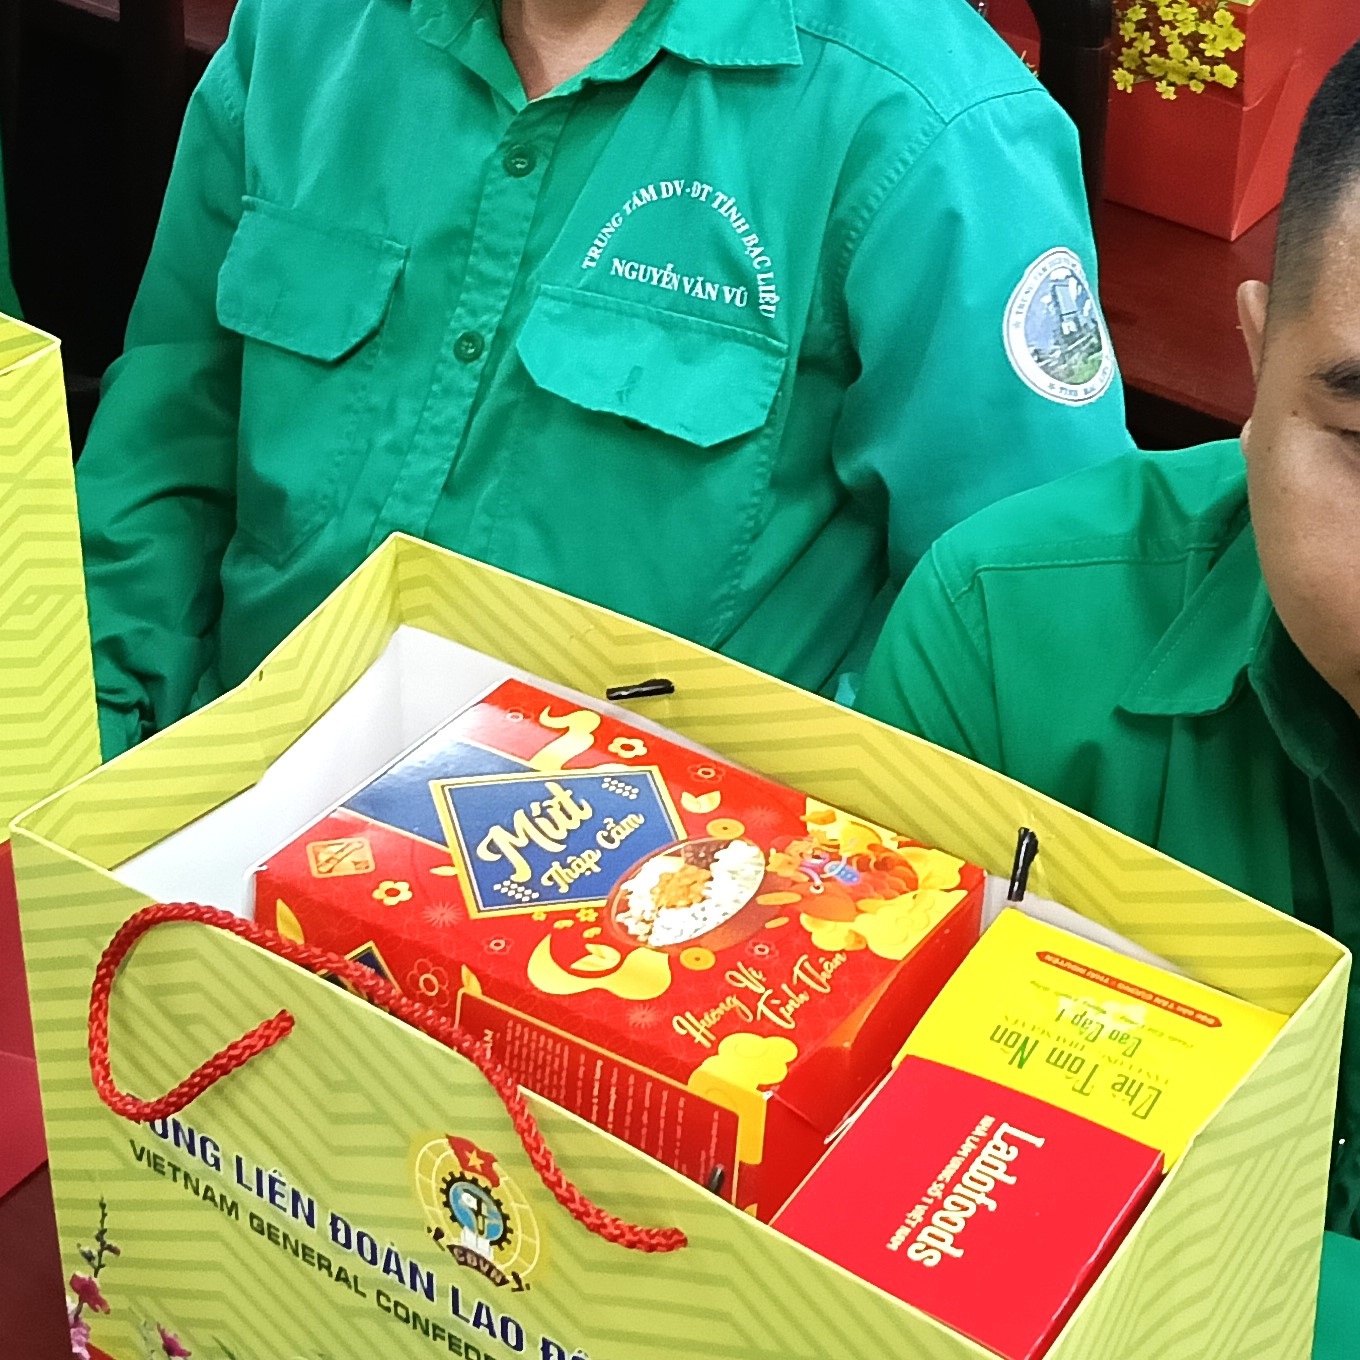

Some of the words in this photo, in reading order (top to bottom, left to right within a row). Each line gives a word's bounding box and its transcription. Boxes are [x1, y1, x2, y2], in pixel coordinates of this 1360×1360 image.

[581, 212, 622, 269] TRUNG
[742, 233, 772, 270] BẠC
[683, 276, 719, 301] VĂN
[477, 781, 593, 883] Mứt
[541, 846, 603, 894] Thập
[595, 810, 645, 851] Cẩm
[671, 991, 755, 1048] Hương
[725, 961, 765, 997] Vị
[755, 983, 811, 1030] Tình
[792, 950, 848, 995] Thân
[1107, 1029, 1143, 1059] Cao
[129, 1139, 240, 1221] VIETNAM
[249, 1211, 368, 1298] GENERAL
[906, 1122, 1046, 1268] Ladofoods
[235, 1166, 317, 1229] LIÊN
[328, 1211, 436, 1303] ĐOÀN
[450, 1285, 525, 1352] LAO
